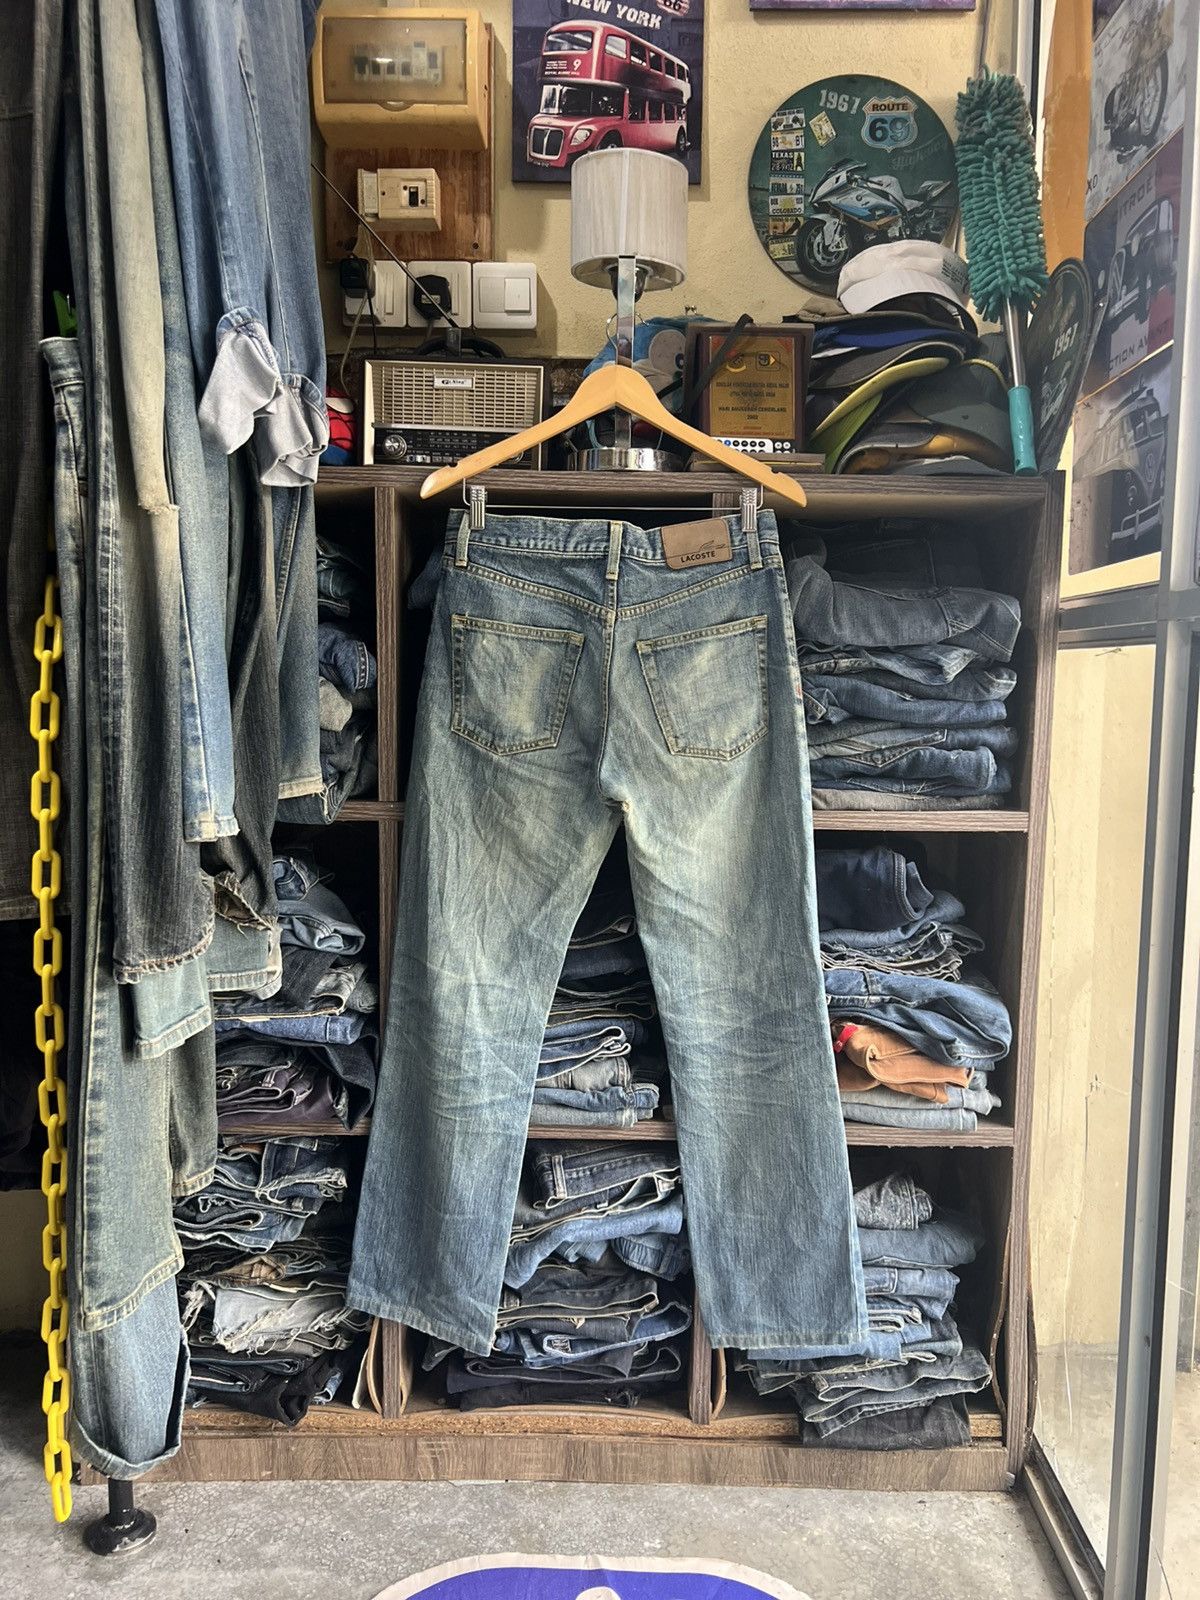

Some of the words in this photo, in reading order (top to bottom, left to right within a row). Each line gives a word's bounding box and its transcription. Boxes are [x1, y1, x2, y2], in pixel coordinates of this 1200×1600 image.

[616, 4, 662, 29] YORK
[573, 59, 582, 71] 9
[819, 89, 861, 115] 1967
[871, 103, 909, 112] ROUTE
[1051, 321, 1079, 361] 1967
[680, 550, 716, 563] LACOSTE
